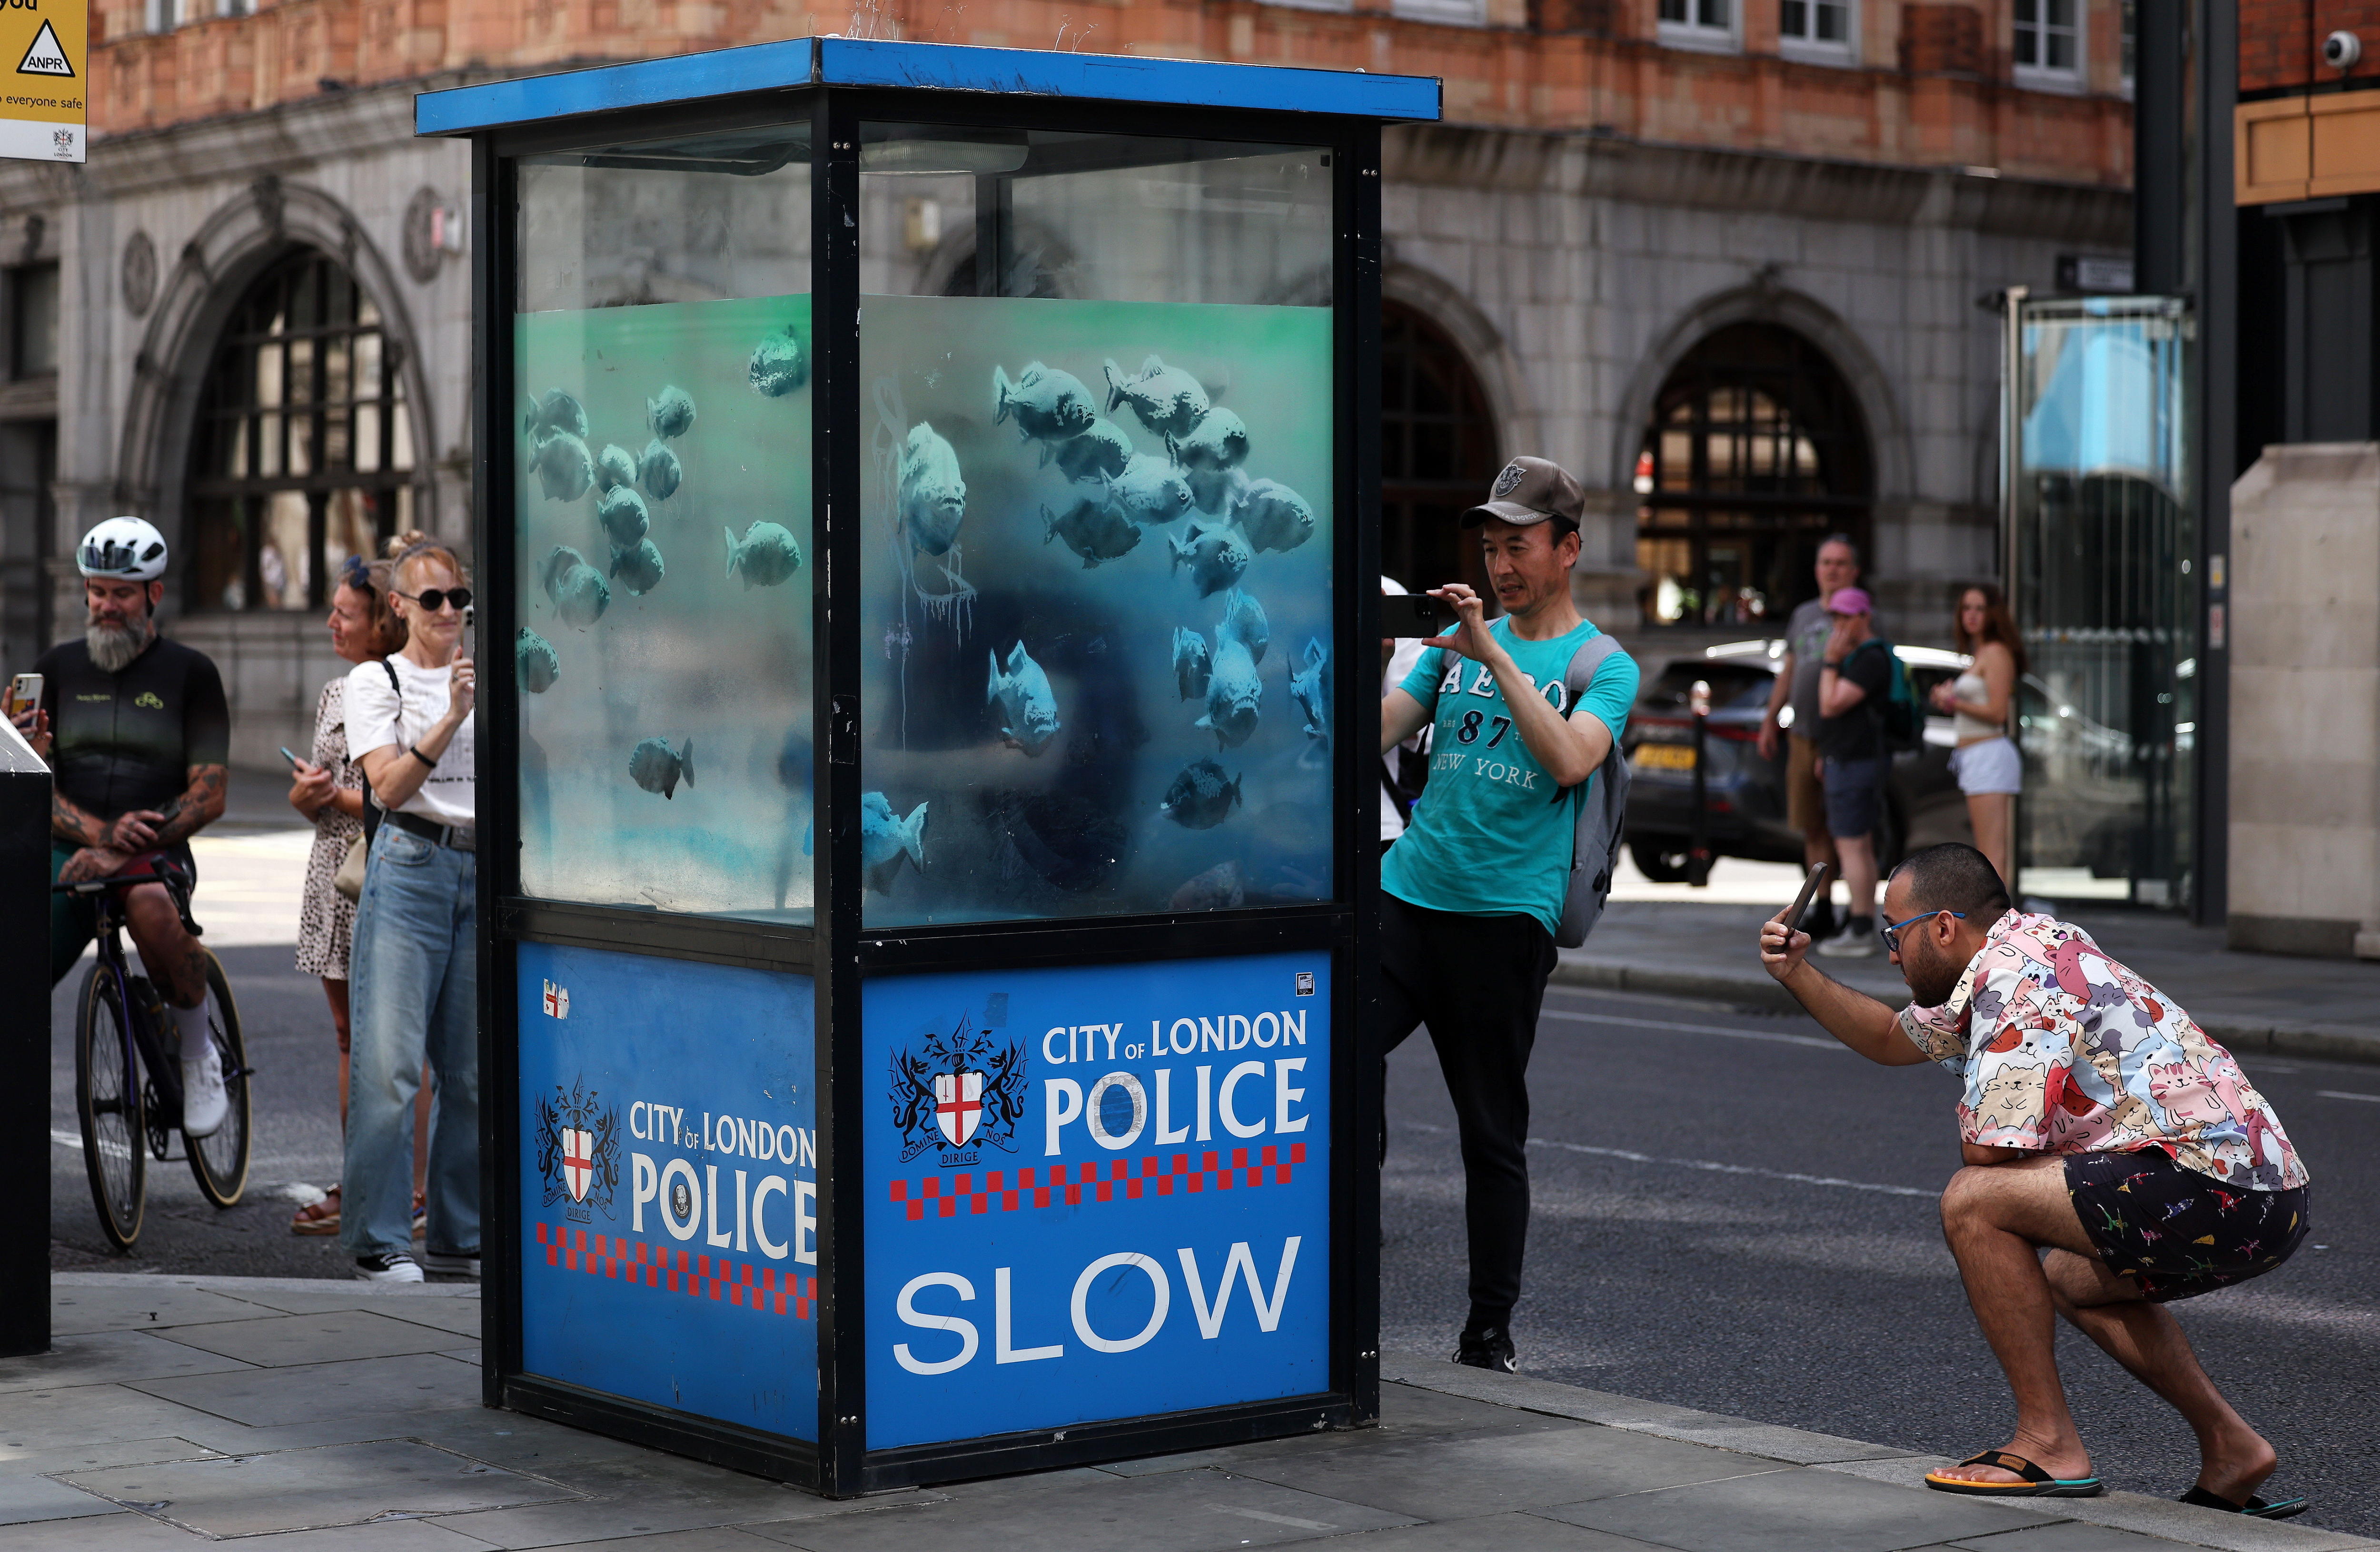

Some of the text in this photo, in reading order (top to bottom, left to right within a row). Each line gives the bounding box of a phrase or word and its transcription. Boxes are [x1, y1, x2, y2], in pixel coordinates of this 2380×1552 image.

[28, 56, 62, 69] ANPR
[6, 96, 57, 108] everyone
[61, 98, 82, 109] safe
[1438, 662, 1567, 713] AEO
[1457, 710, 1511, 749] 87
[1433, 753, 1538, 790] NEW YORK
[1043, 1009, 1307, 1065] CITY OF LONDON
[1044, 1057, 1310, 1157] POLICE
[630, 1101, 816, 1169] CITY OF LONDON
[902, 1128, 1005, 1164] DOMINE DIRIGE NOS
[543, 1183, 607, 1220] DOMINE DIRIGE NOS
[631, 1152, 817, 1266] POLICE
[893, 1236, 1302, 1375] SLOW
